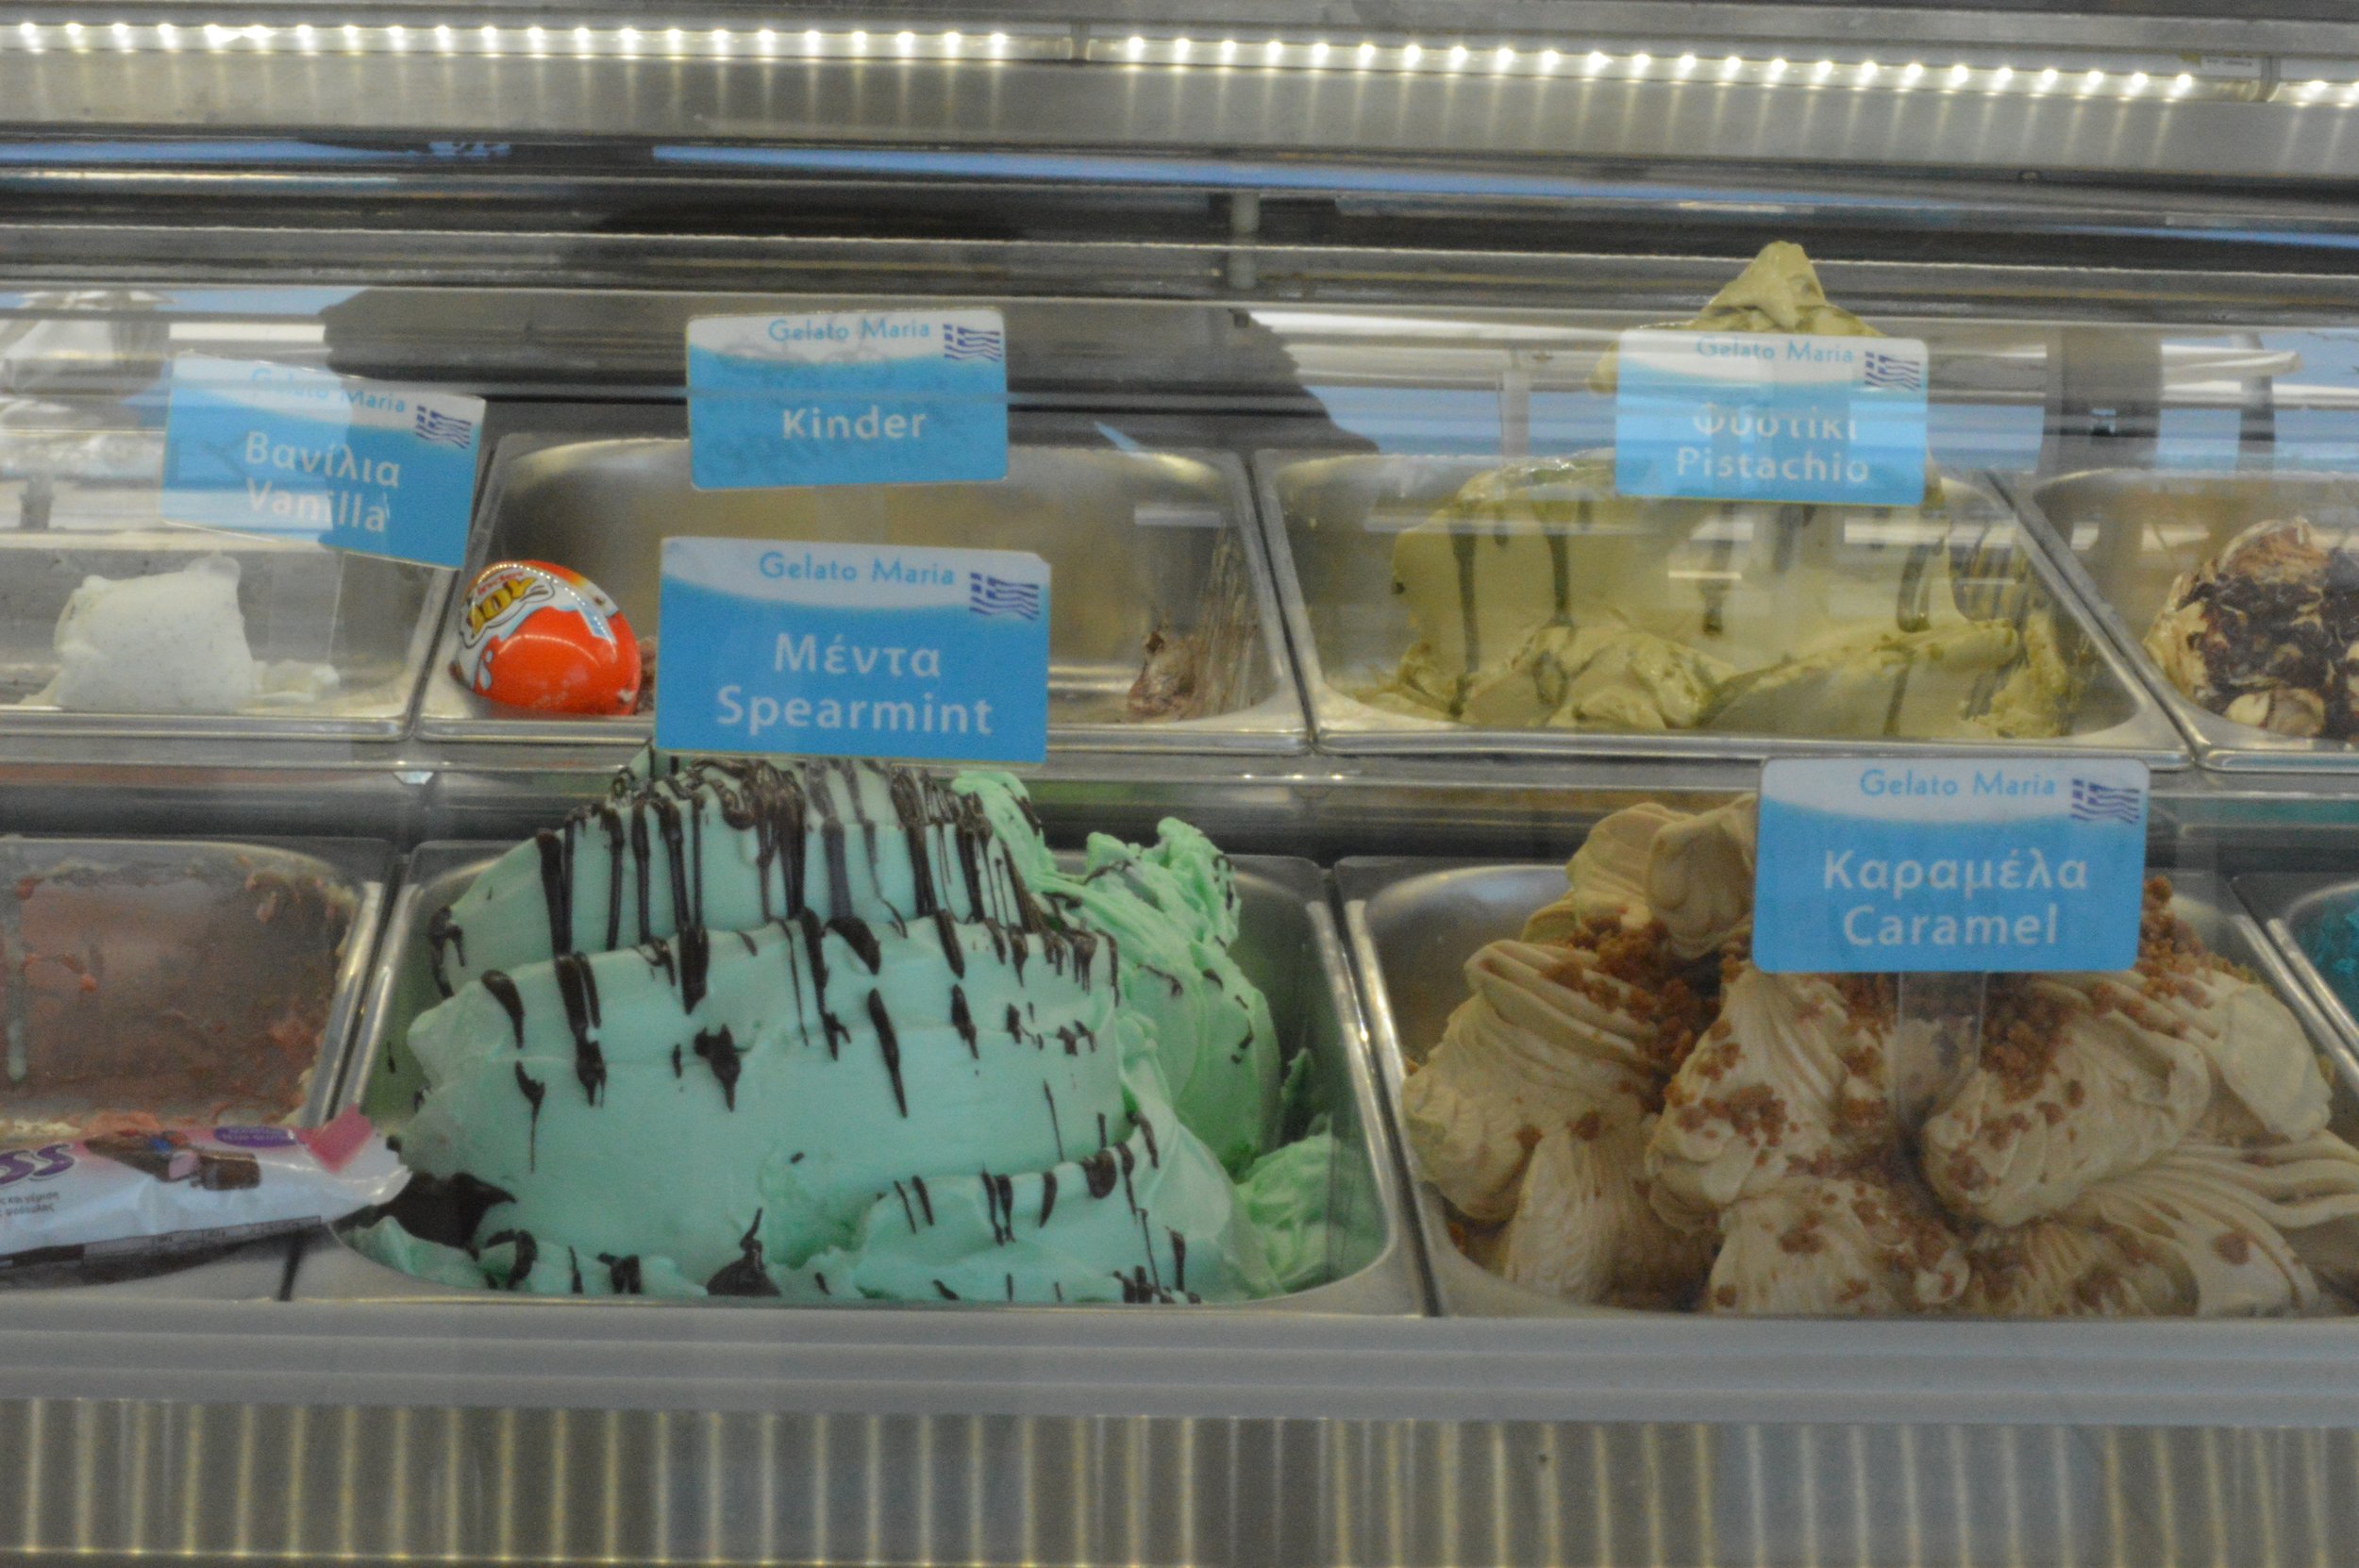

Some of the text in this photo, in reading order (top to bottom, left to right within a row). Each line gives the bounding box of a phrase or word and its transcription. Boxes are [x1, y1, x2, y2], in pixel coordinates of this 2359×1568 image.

[767, 318, 930, 342] Gelato Maria
[1696, 336, 1854, 363] Gelato Maria
[251, 367, 407, 413] Glato Maria
[782, 405, 928, 440] Kinder
[245, 430, 401, 489] Βανίλια
[1676, 446, 1870, 483] Pistachio
[245, 476, 388, 533] Vanilla
[759, 550, 956, 586] Gelato Maria
[773, 632, 942, 677] Μέντα
[716, 684, 994, 737] Spearmint
[1859, 768, 2056, 798] Gelato Maria
[1823, 847, 2088, 901] Καραμέλα
[1843, 903, 2059, 946] Caramel
